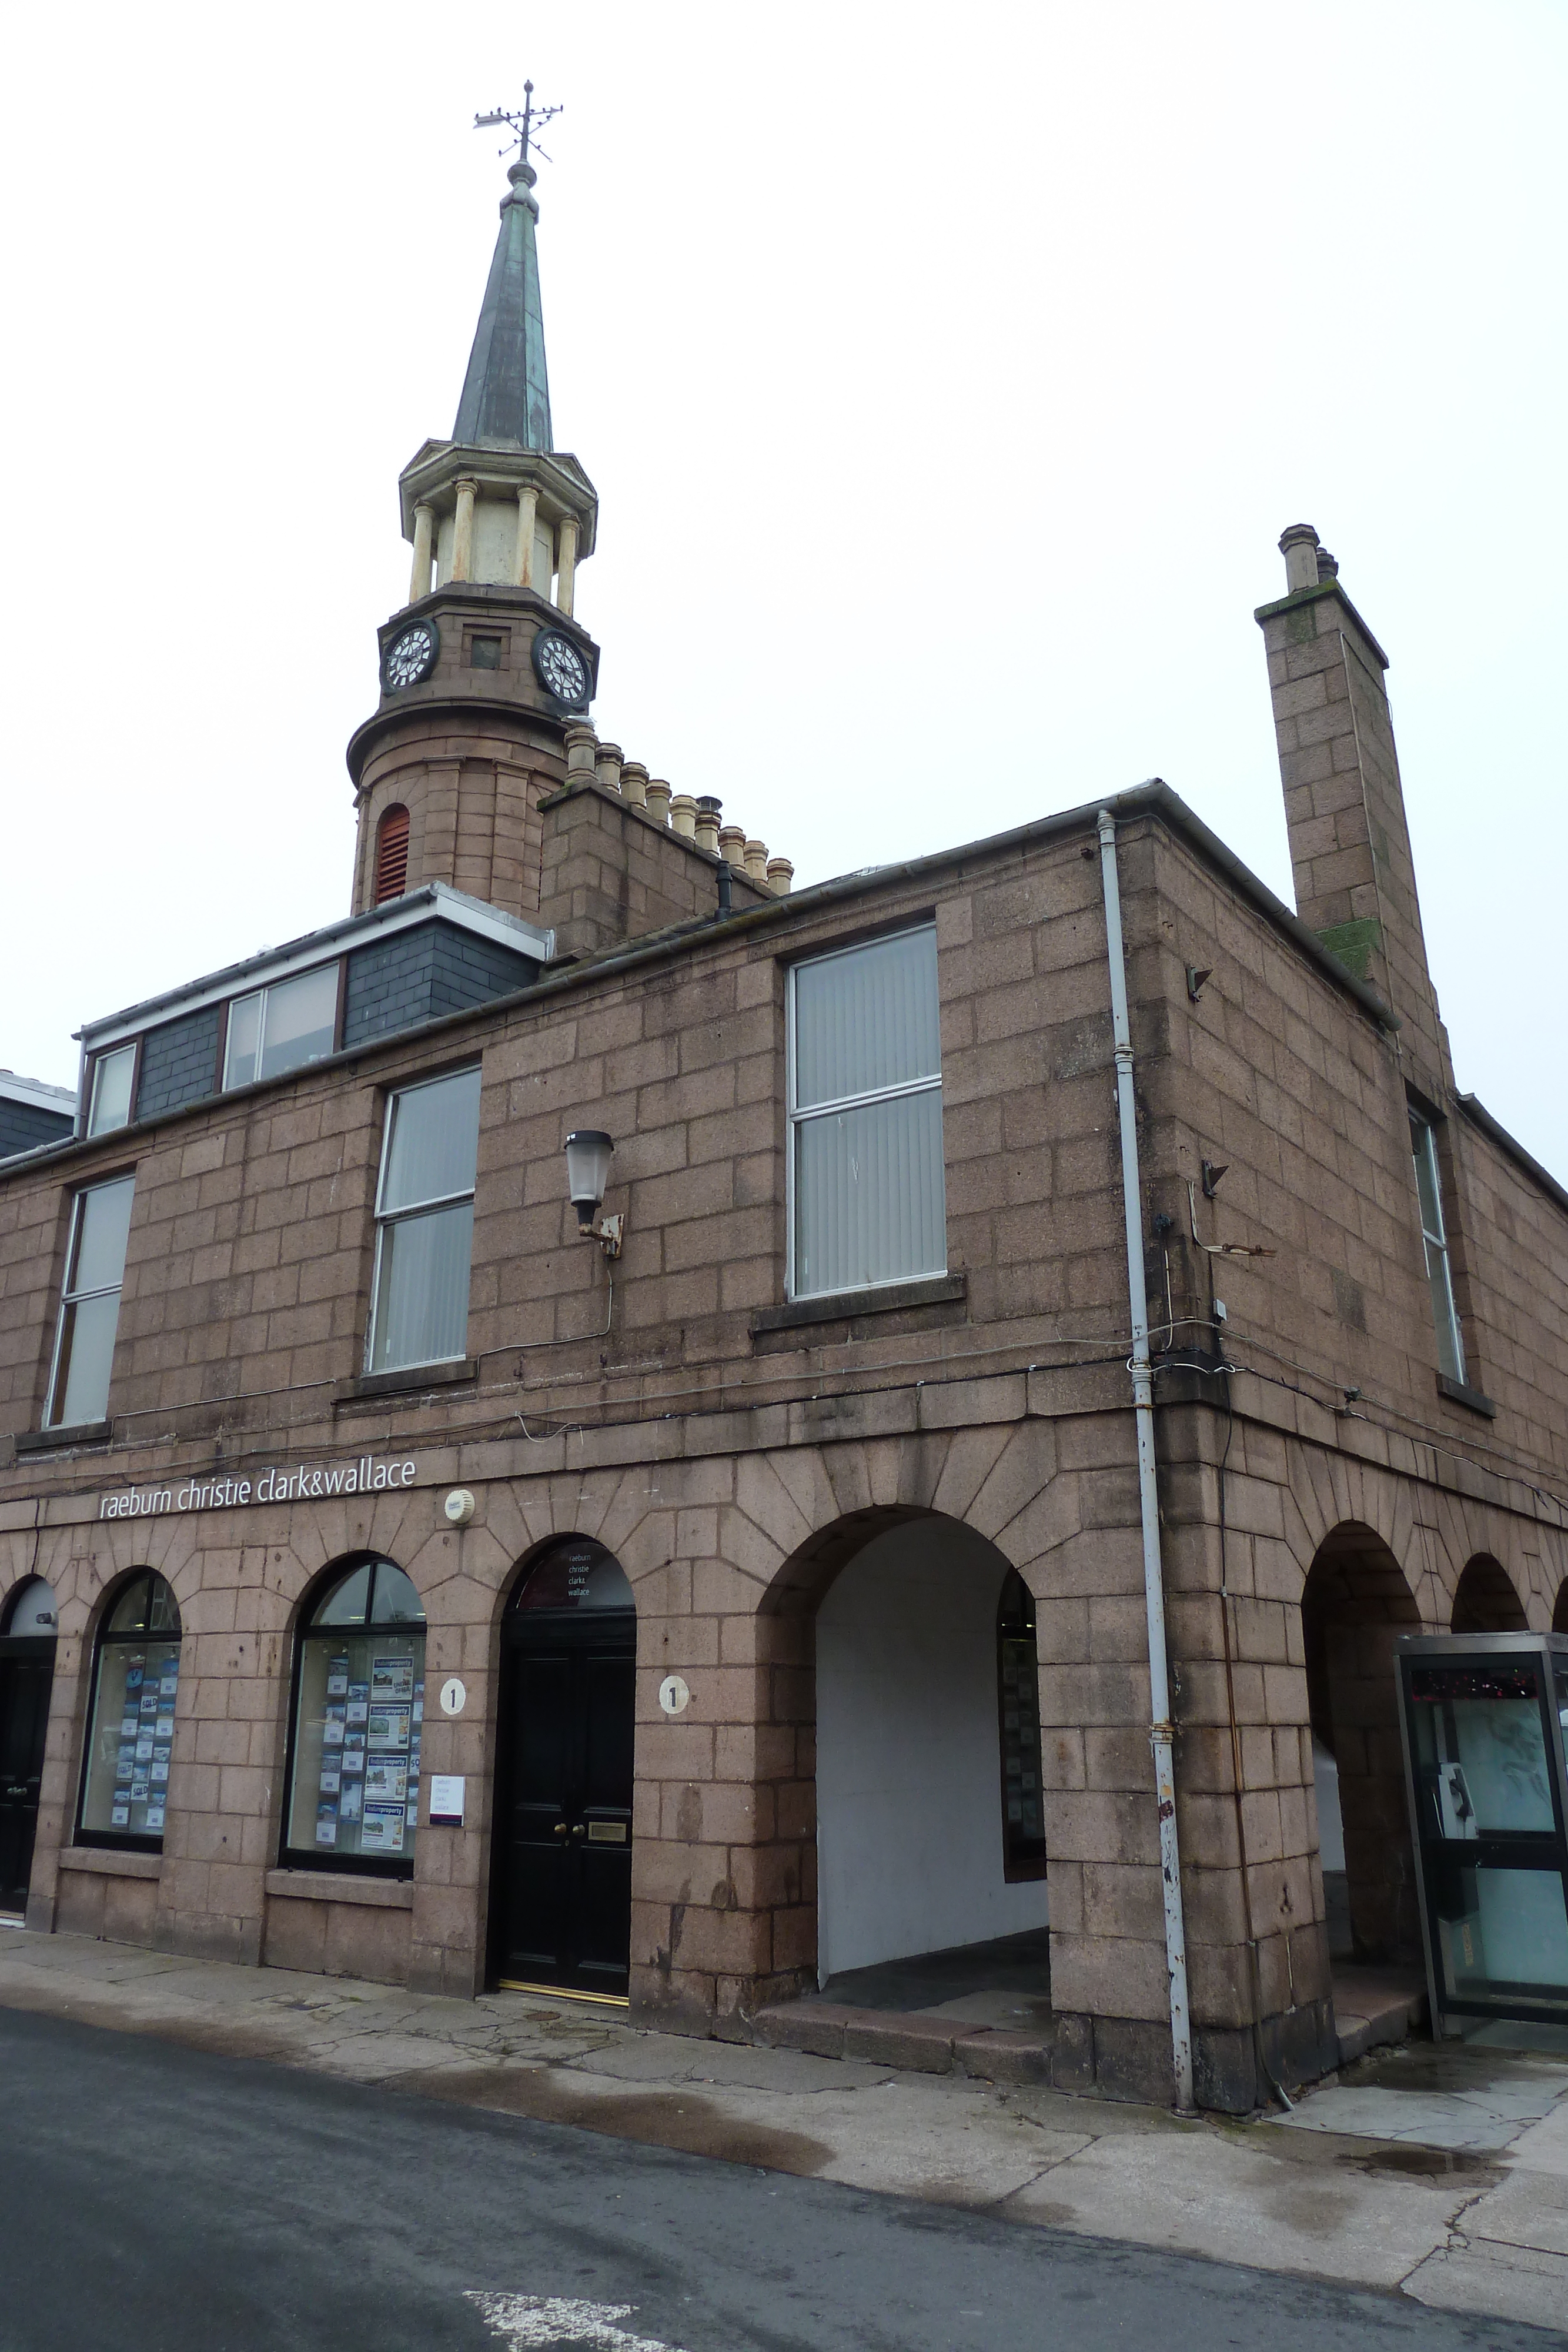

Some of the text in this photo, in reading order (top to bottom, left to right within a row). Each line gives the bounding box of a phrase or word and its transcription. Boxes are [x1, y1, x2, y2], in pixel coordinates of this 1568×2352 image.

[100, 1486, 172, 1519] raeburn
[178, 1478, 251, 1511] christie
[569, 1565, 589, 1573] christie
[568, 1588, 590, 1596] wallace
[450, 1688, 456, 1708] 1
[669, 1687, 676, 1708] 1
[142, 1698, 158, 1709] SOLD
[133, 1786, 148, 1797] SOLD
